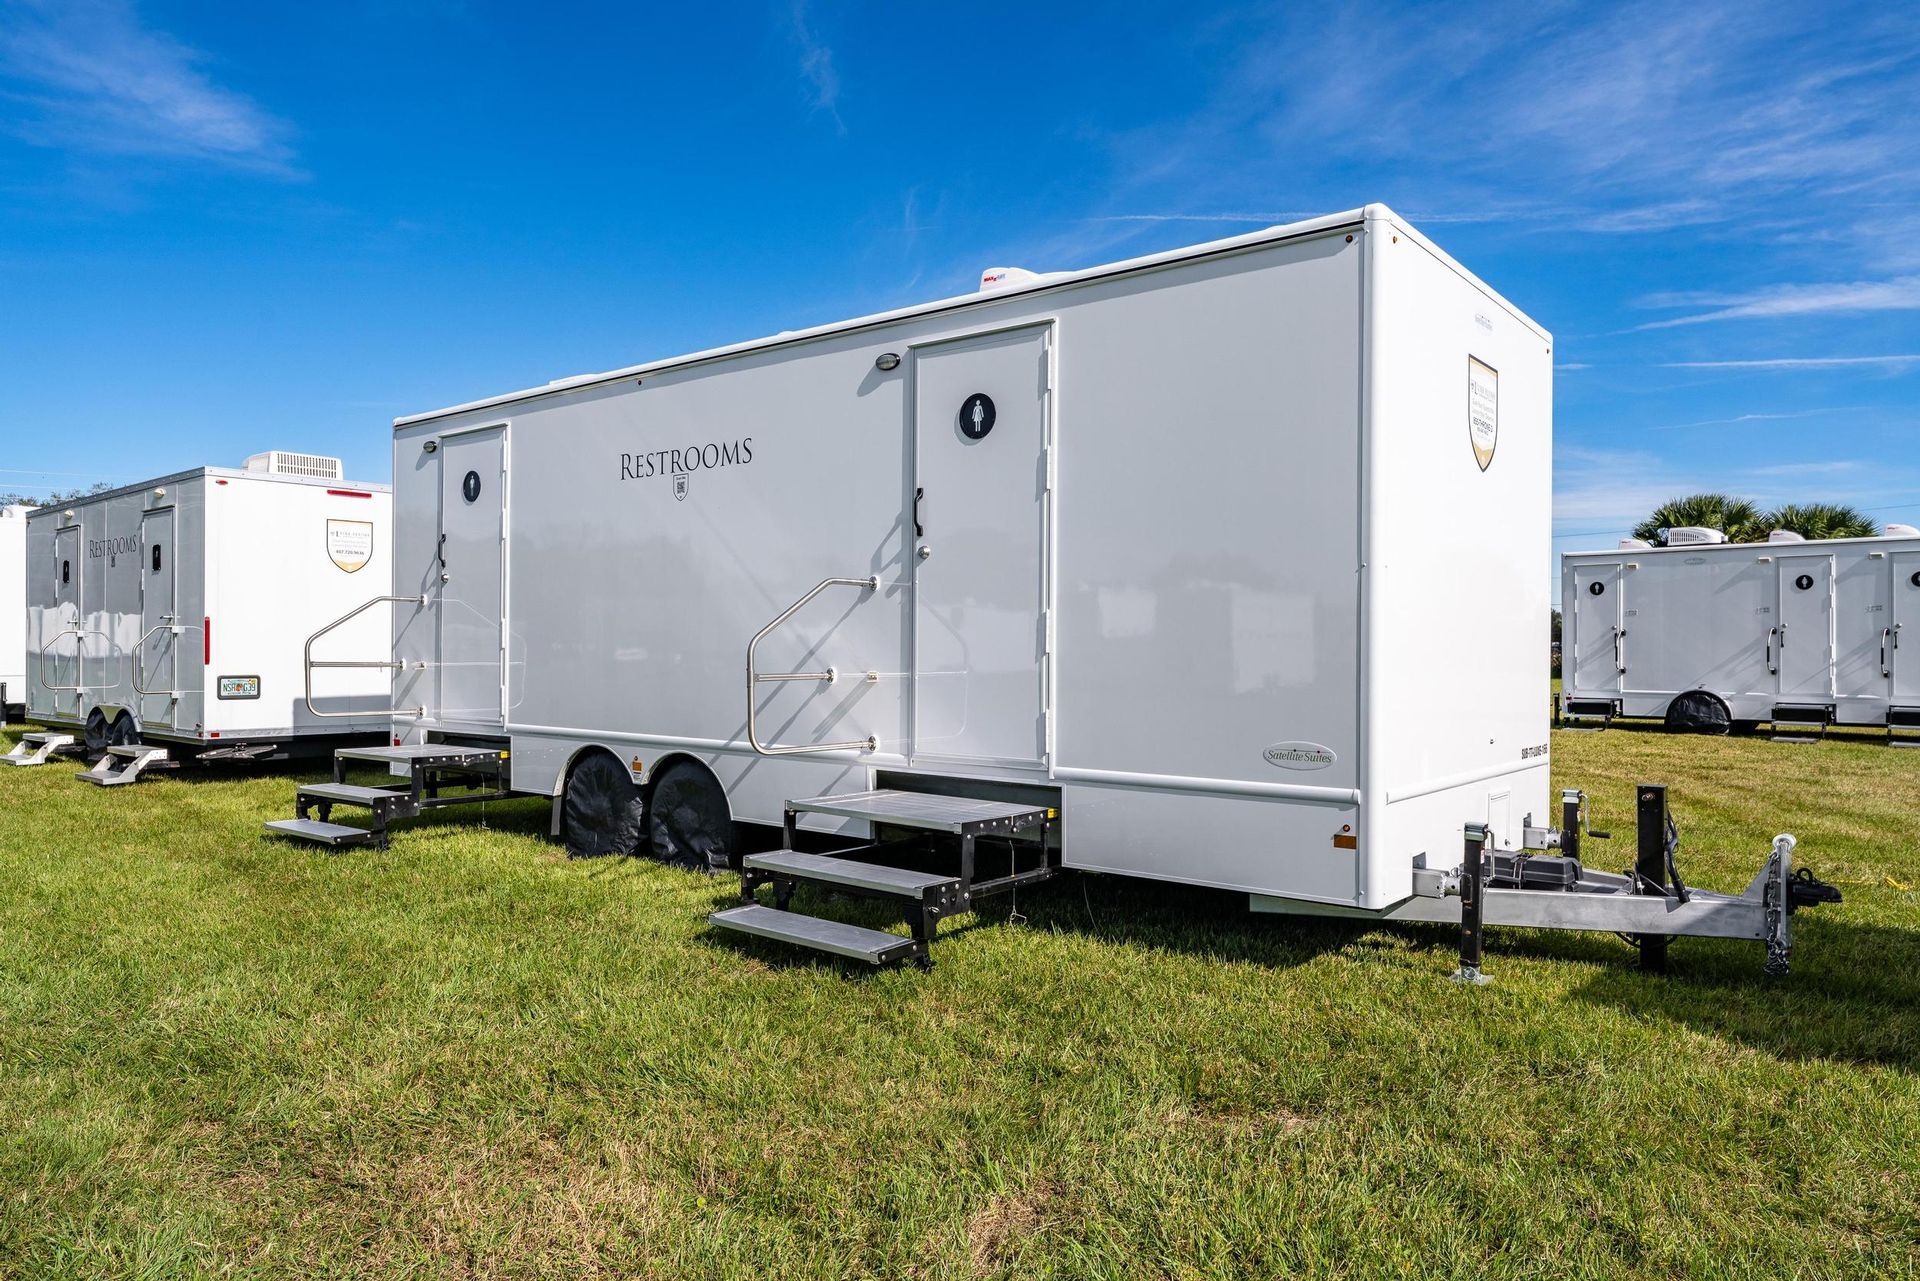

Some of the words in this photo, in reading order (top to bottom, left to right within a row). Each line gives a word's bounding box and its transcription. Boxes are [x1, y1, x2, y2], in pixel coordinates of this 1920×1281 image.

[620, 437, 753, 481] RESTROOMS
[89, 534, 137, 559] RESTROOMS
[1267, 749, 1304, 762] Satellite
[1303, 751, 1332, 764] Suites
